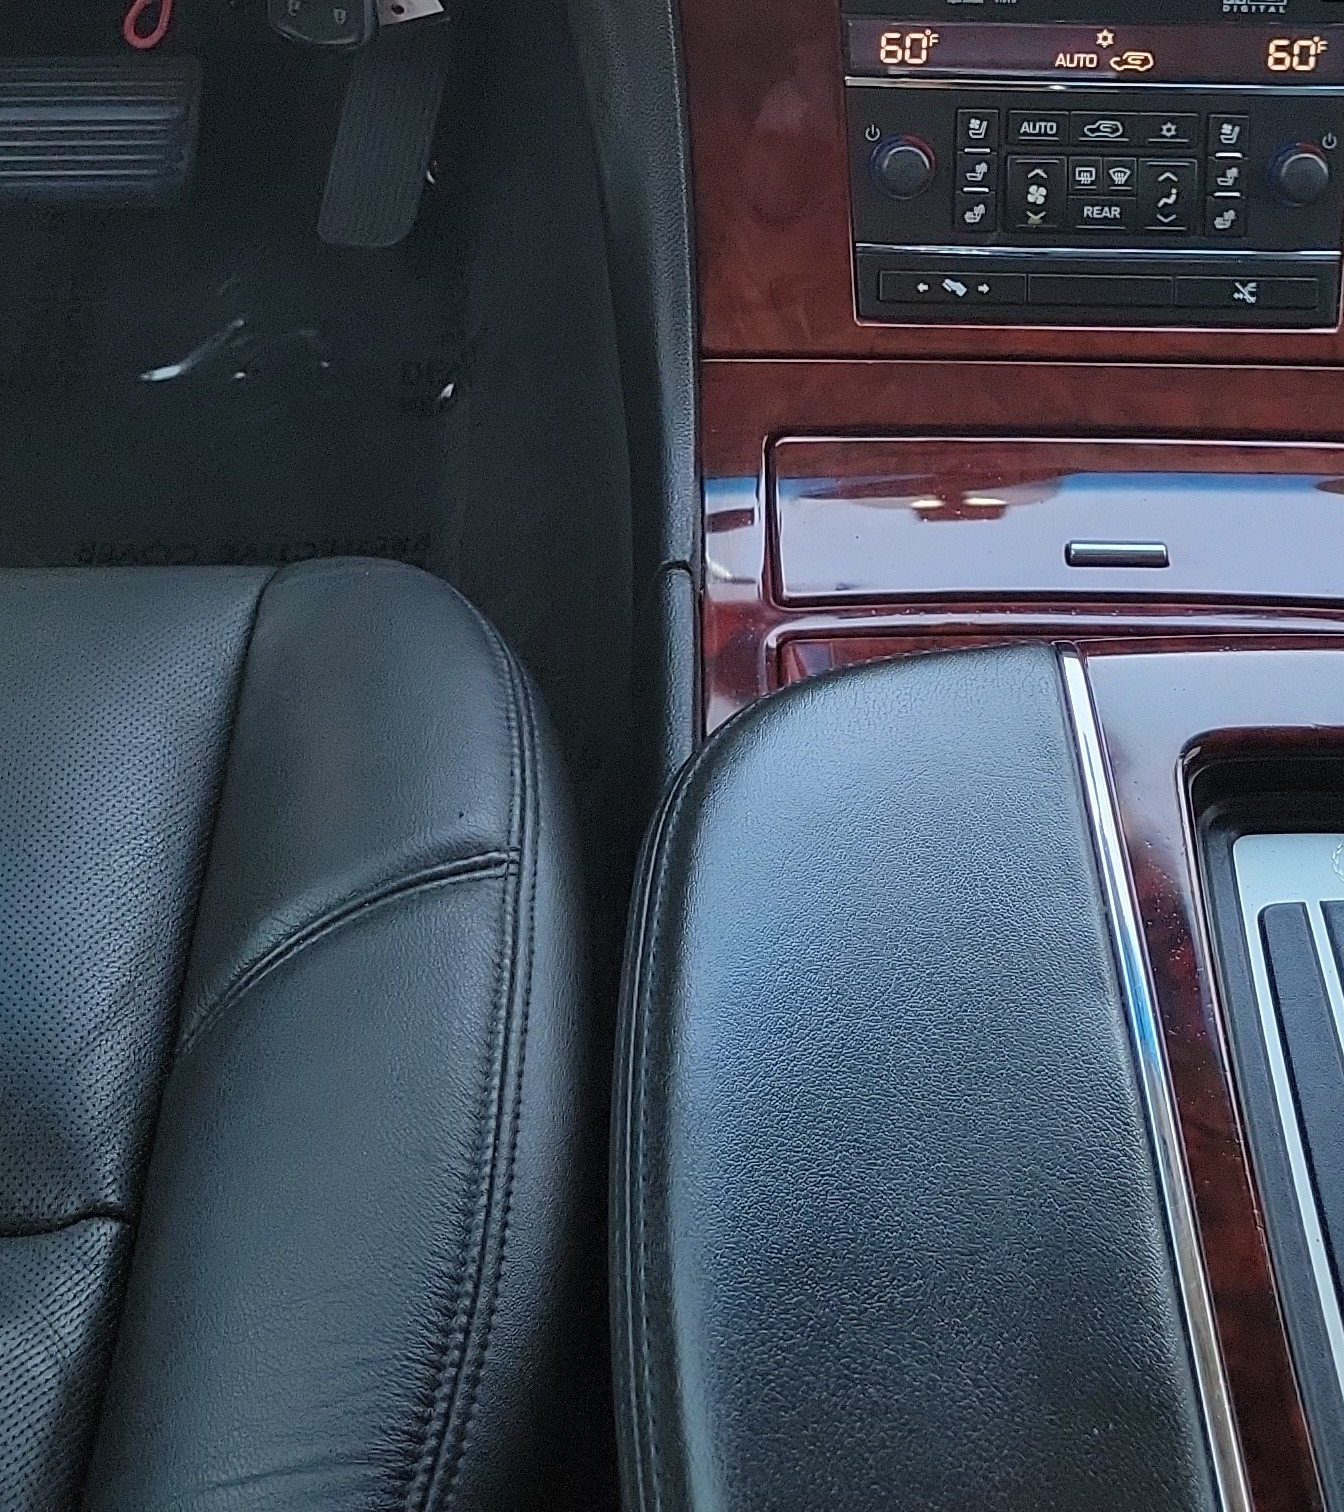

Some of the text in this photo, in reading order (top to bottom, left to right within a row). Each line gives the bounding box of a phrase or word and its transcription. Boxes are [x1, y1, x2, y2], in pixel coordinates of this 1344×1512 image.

[1223, 5, 1286, 13] DIGITAL
[1055, 53, 1098, 68] AUTO
[1020, 121, 1056, 134] AUTO
[1083, 206, 1121, 219] REAR
